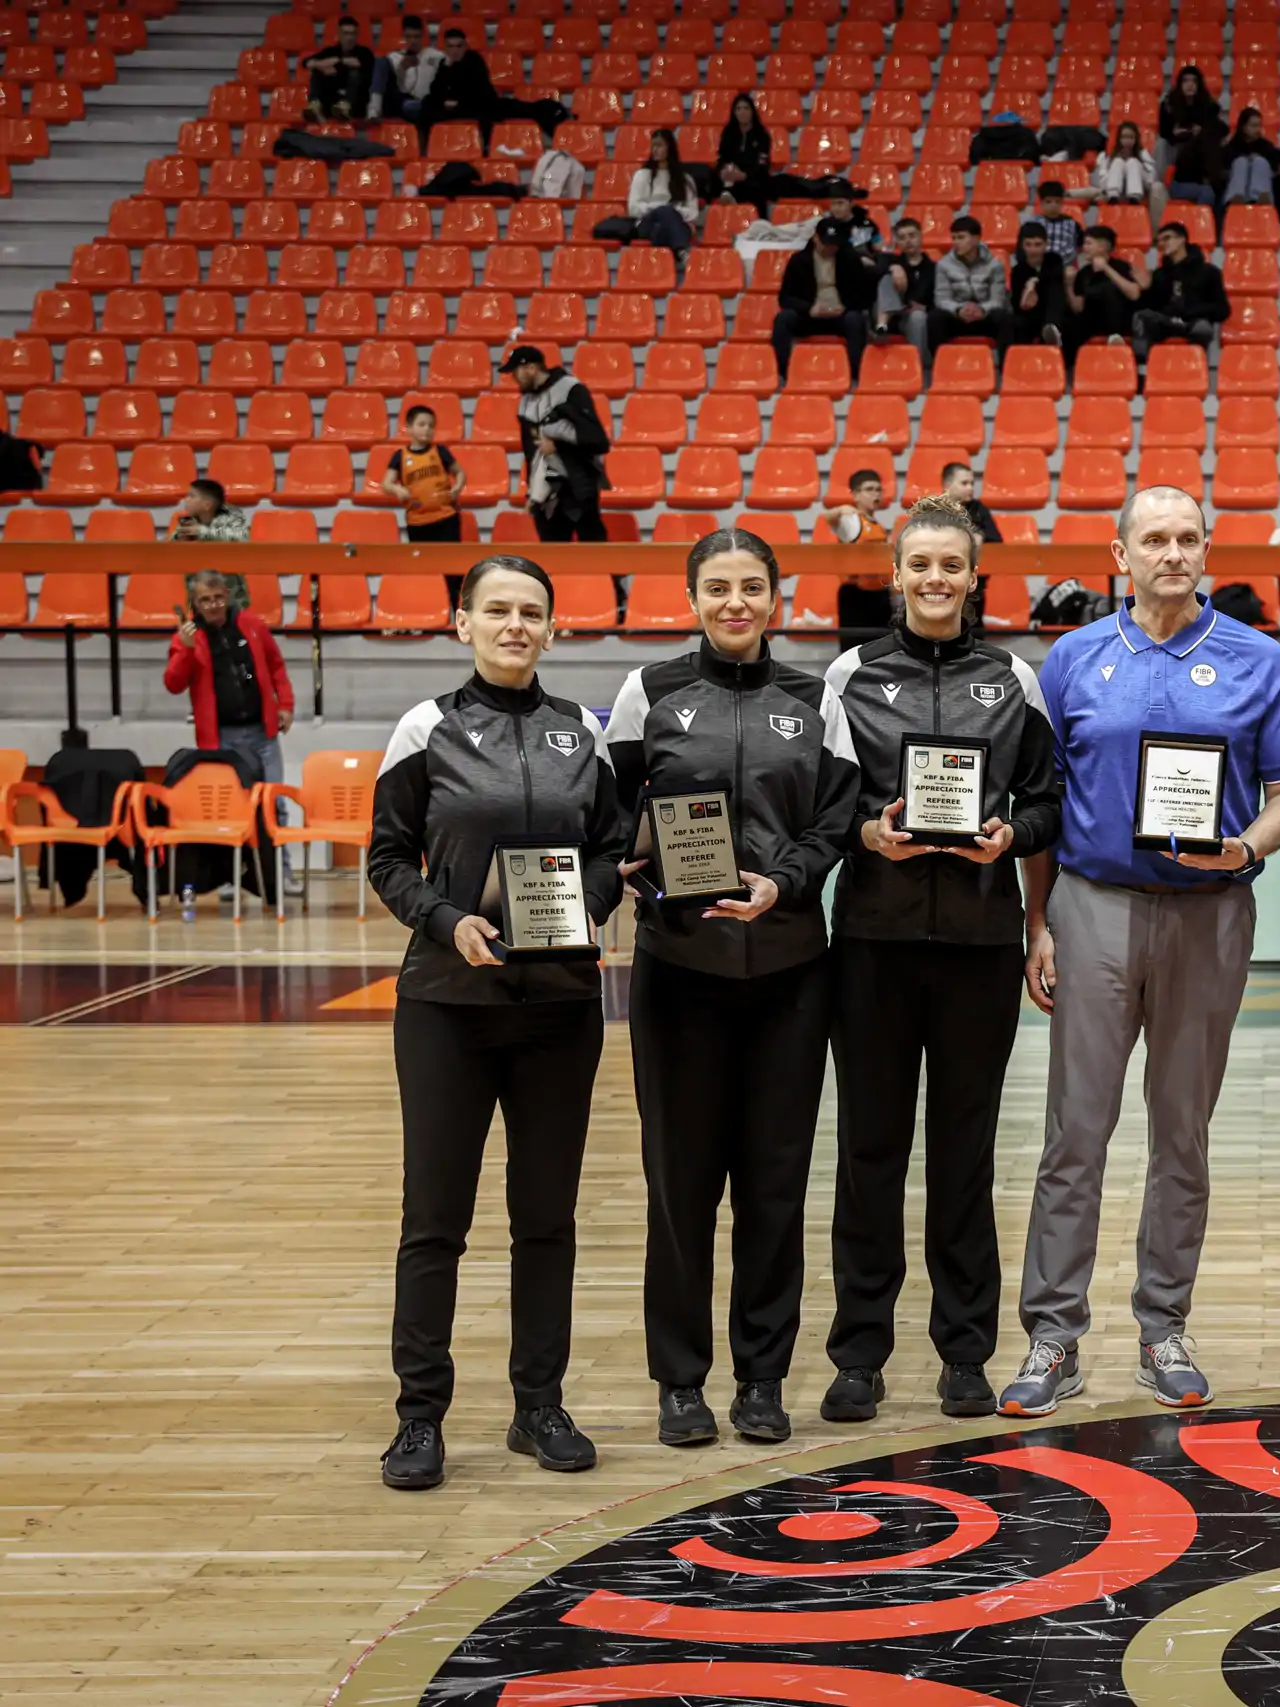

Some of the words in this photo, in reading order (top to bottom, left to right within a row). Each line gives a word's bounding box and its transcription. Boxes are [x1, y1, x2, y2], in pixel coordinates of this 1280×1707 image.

[980, 687, 995, 695] FIBA
[915, 785, 973, 793] APPRECIATION
[1153, 786, 1210, 795] APPRECIATION
[667, 838, 726, 850] APPRECIATION
[681, 853, 716, 863] REFEREE
[516, 894, 577, 902] APPRECIATION
[530, 908, 566, 916] REFEREE
